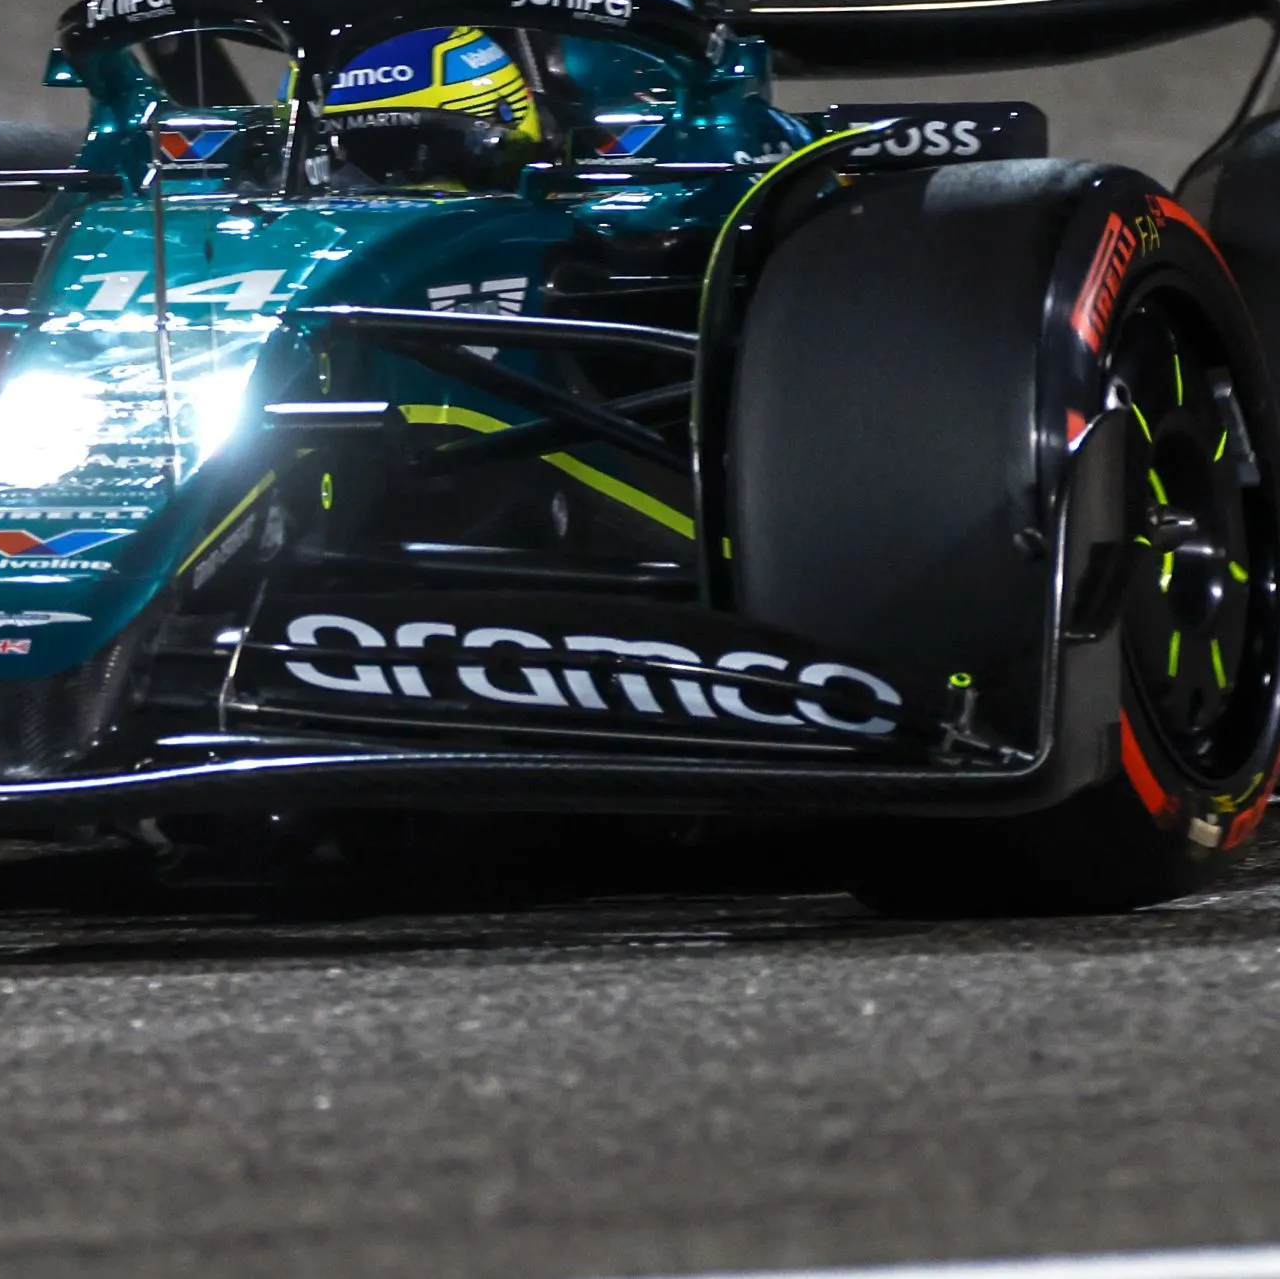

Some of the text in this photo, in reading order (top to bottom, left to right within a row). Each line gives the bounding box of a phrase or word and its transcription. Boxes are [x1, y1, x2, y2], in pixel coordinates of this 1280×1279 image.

[79, 269, 295, 312] 14
[1070, 211, 1137, 354] PIRELLI
[284, 614, 902, 734] aramco
